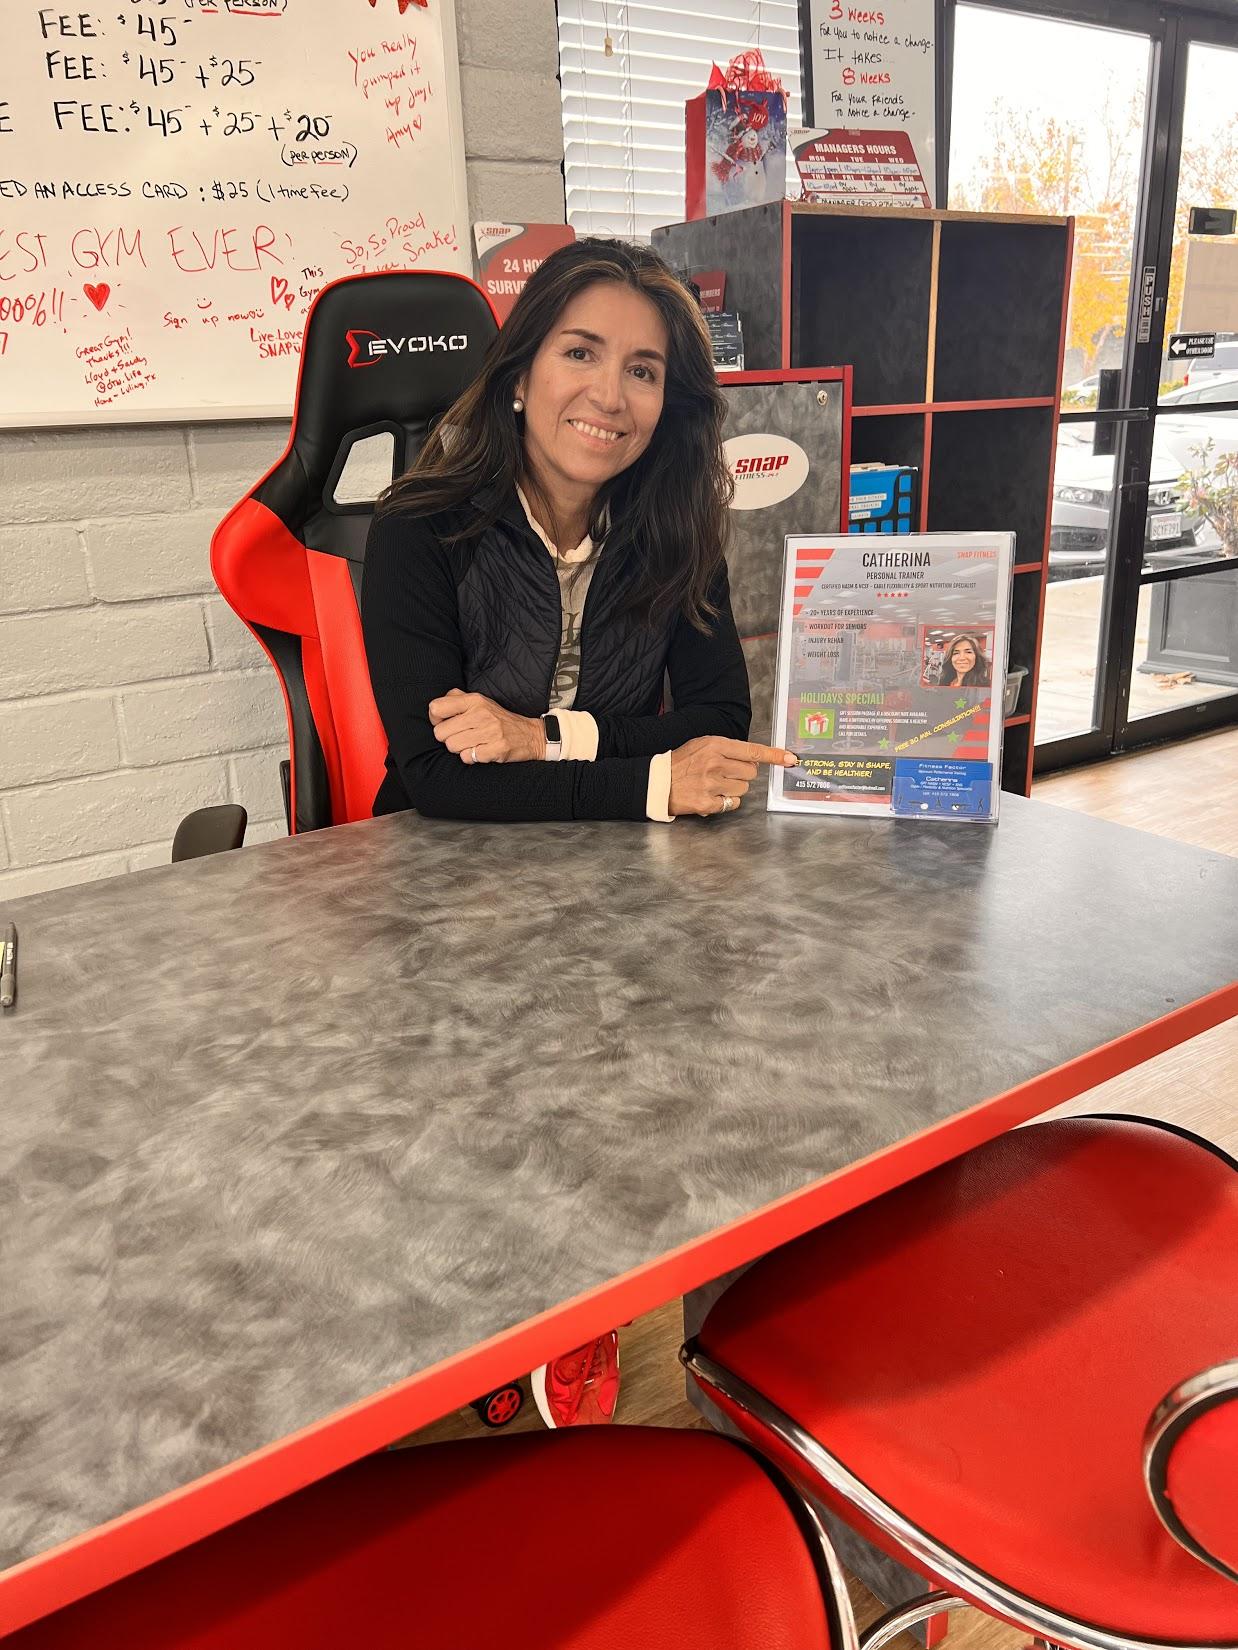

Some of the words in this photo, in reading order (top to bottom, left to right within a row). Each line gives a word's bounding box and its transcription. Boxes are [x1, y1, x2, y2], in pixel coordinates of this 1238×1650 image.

[829, 0, 843, 19] 3
[38, 9, 105, 38] FEE:
[851, 29, 860, 40] to
[894, 37, 901, 45] a
[823, 48, 844, 62] It
[46, 50, 106, 80] FEE:
[410, 60, 421, 76] it
[842, 67, 855, 86] 8
[384, 95, 400, 116] up
[54, 101, 130, 132] FEE:
[752, 112, 765, 124] JOY
[814, 143, 865, 154] MANAGERS
[867, 145, 897, 155] HOURS
[34, 182, 56, 199] AN
[62, 181, 131, 199] ACCESS
[142, 182, 188, 199] CARD
[212, 180, 249, 201] $25
[71, 227, 147, 269] GYM
[301, 265, 324, 280] This
[503, 259, 520, 273] 24
[1142, 274, 1154, 318] PUSH
[163, 311, 188, 329] Sign
[202, 314, 219, 328] up
[227, 313, 250, 322] now
[259, 342, 293, 359] SNAP
[863, 552, 932, 567] CATHERINA
[957, 551, 972, 559] SNAP
[974, 550, 997, 558] FITNESS
[867, 572, 897, 580] PERSONAL
[800, 692, 843, 704] HOLIDAYS
[894, 742, 910, 752] FREE
[804, 760, 836, 768] STRONG,
[866, 762, 892, 770] SHAPE,
[834, 770, 873, 778] HEALTHIER!
